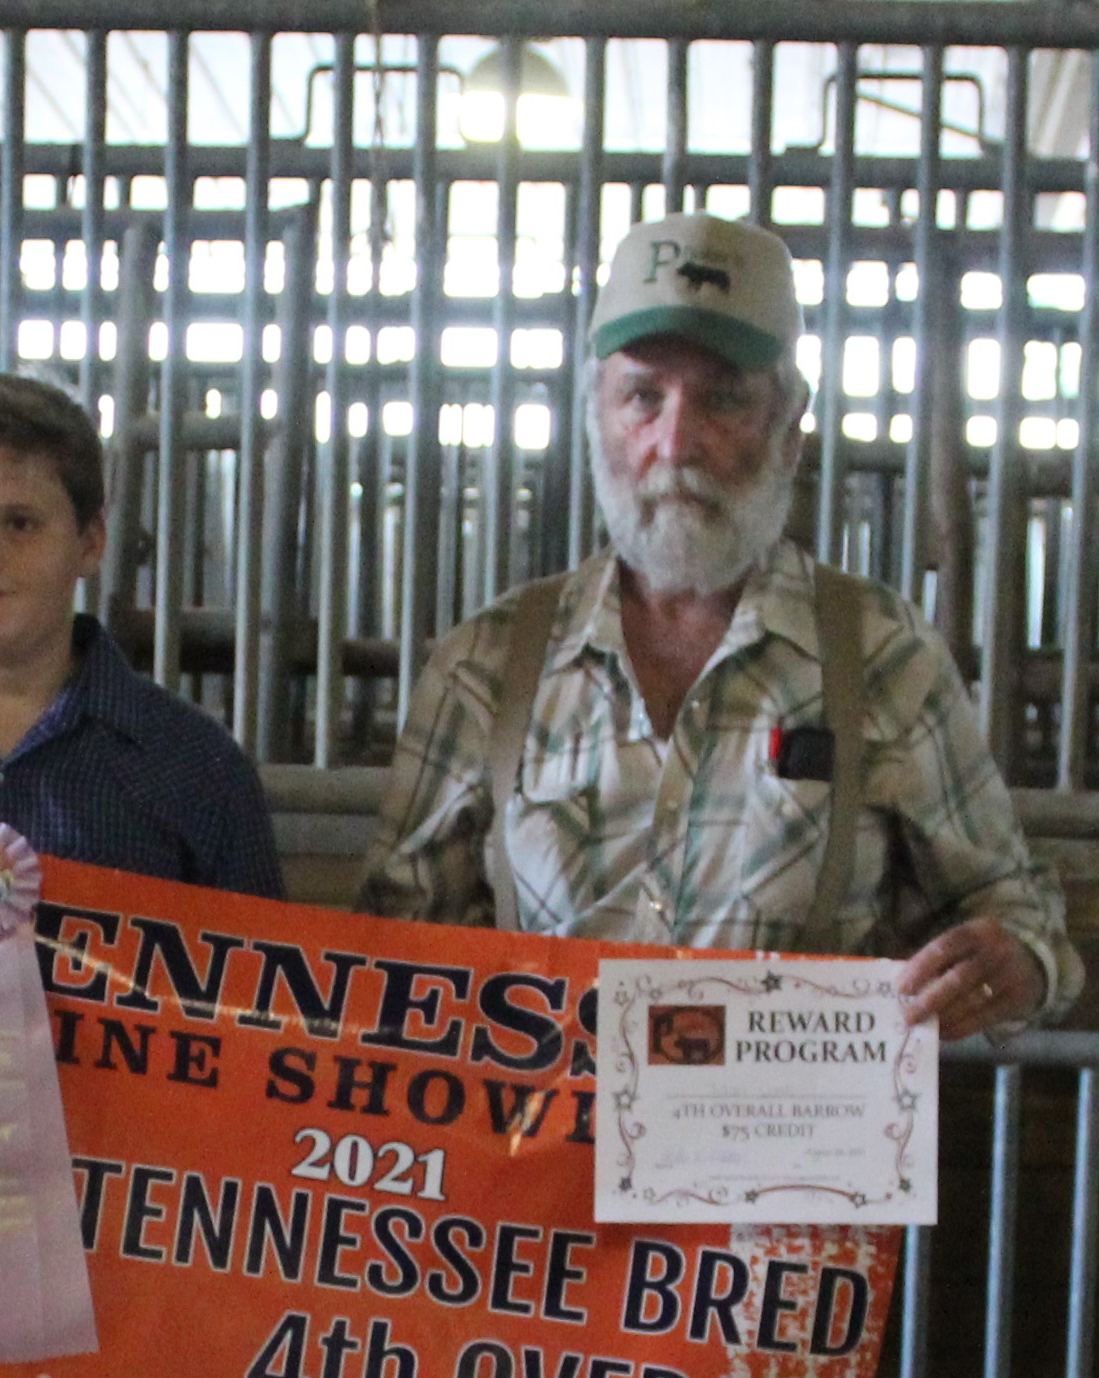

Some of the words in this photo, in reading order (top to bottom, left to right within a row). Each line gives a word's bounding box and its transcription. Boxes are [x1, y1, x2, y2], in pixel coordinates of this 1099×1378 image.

[747, 1010, 875, 1034] REWARD
[735, 1040, 887, 1063] PROGRAM
[709, 1103, 785, 1118] OVERALL
[791, 1103, 866, 1118] BARROW
[754, 1123, 815, 1138] CREDIT
[292, 1128, 446, 1200] 2021
[73, 1157, 597, 1326] TENNESSEE
[623, 1238, 871, 1358] BRED
